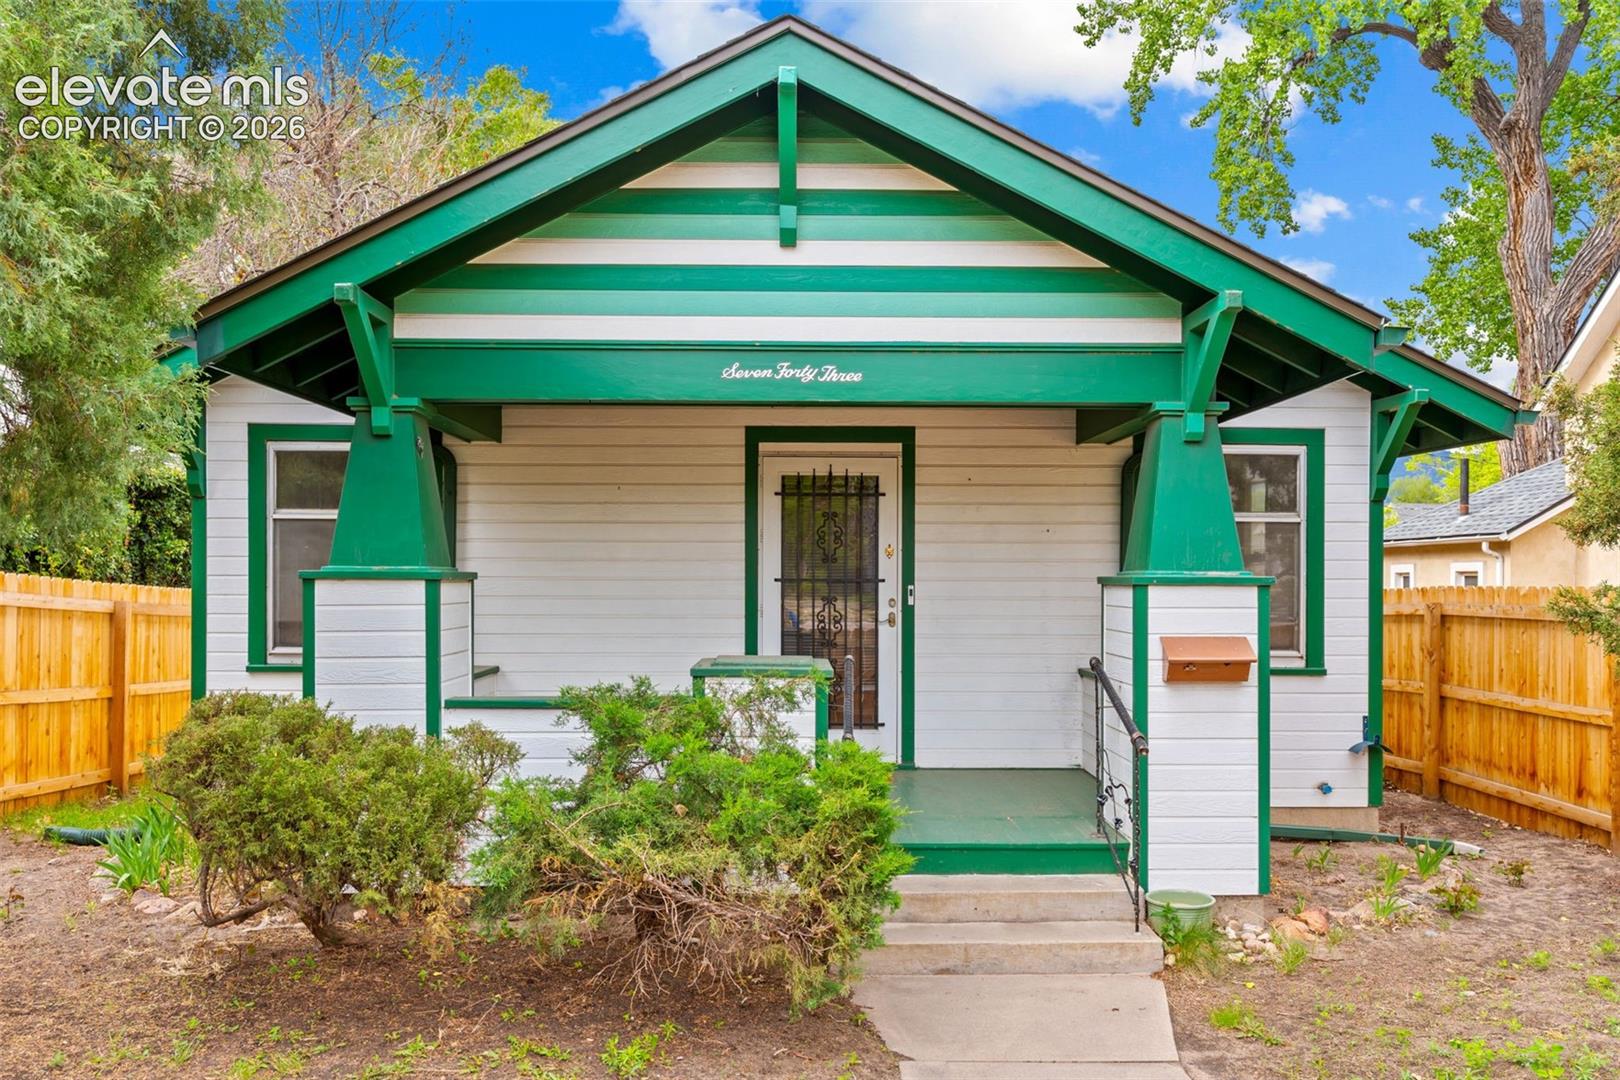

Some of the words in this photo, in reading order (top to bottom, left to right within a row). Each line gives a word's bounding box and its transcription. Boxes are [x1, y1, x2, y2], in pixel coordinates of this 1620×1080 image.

[721, 362, 773, 379] Seven
[774, 362, 818, 383] Forty
[817, 365, 864, 382] Three
